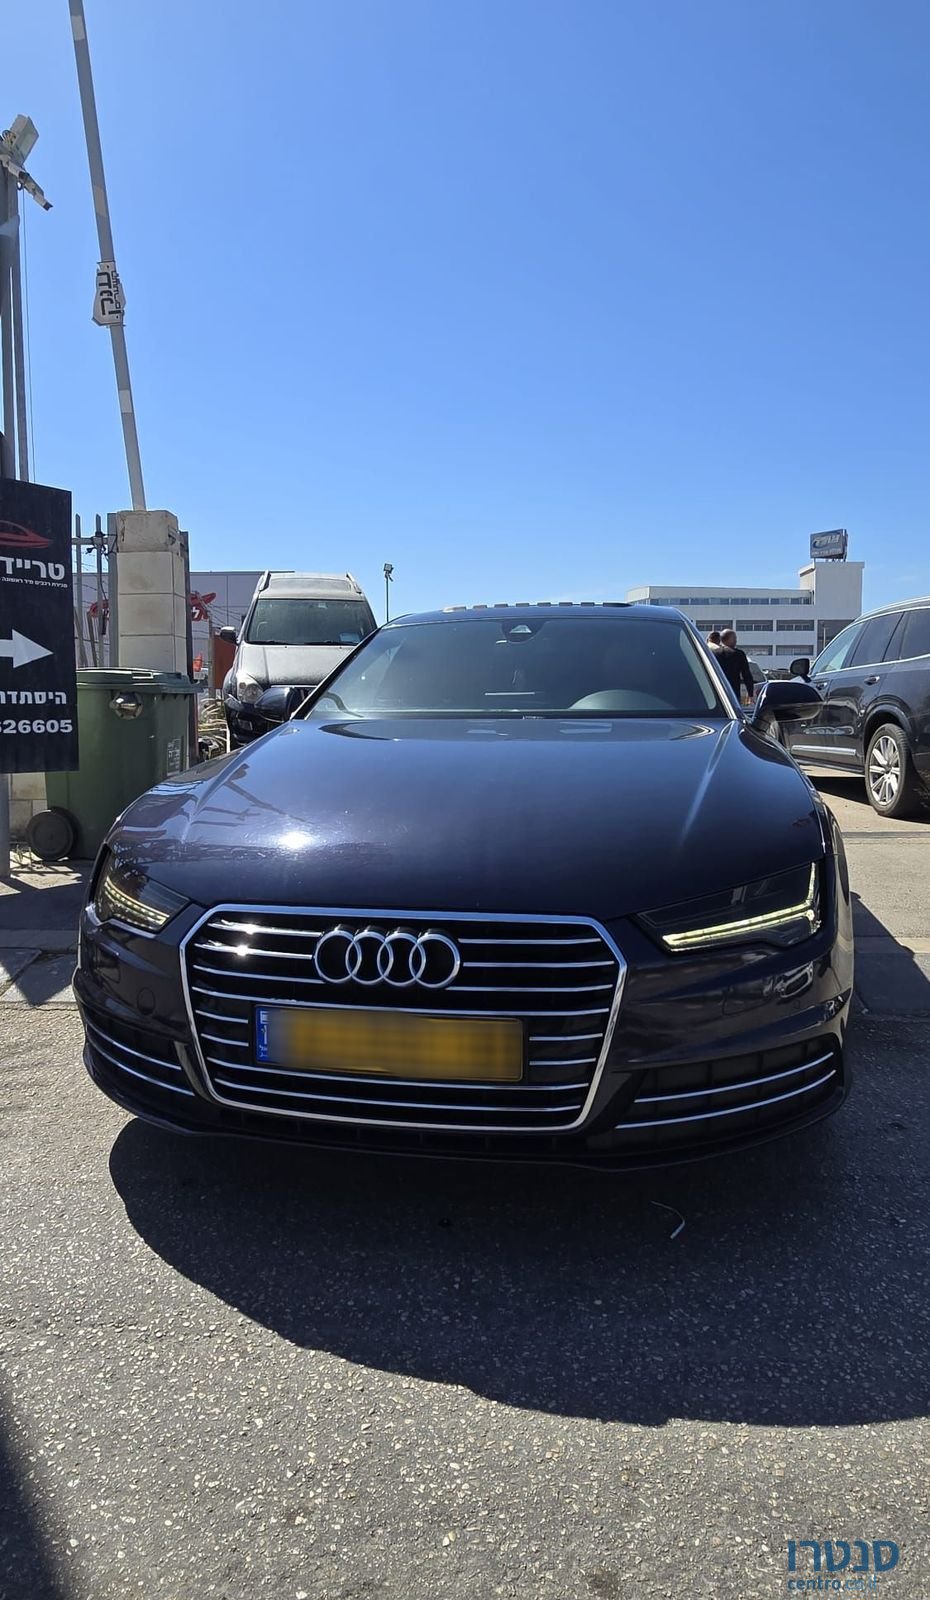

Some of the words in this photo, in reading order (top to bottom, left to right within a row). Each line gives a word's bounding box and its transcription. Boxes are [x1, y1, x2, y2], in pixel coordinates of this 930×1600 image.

[97, 271, 122, 316] ענק
[0, 556, 65, 581] טרייד
[0, 719, 73, 734] 26605
